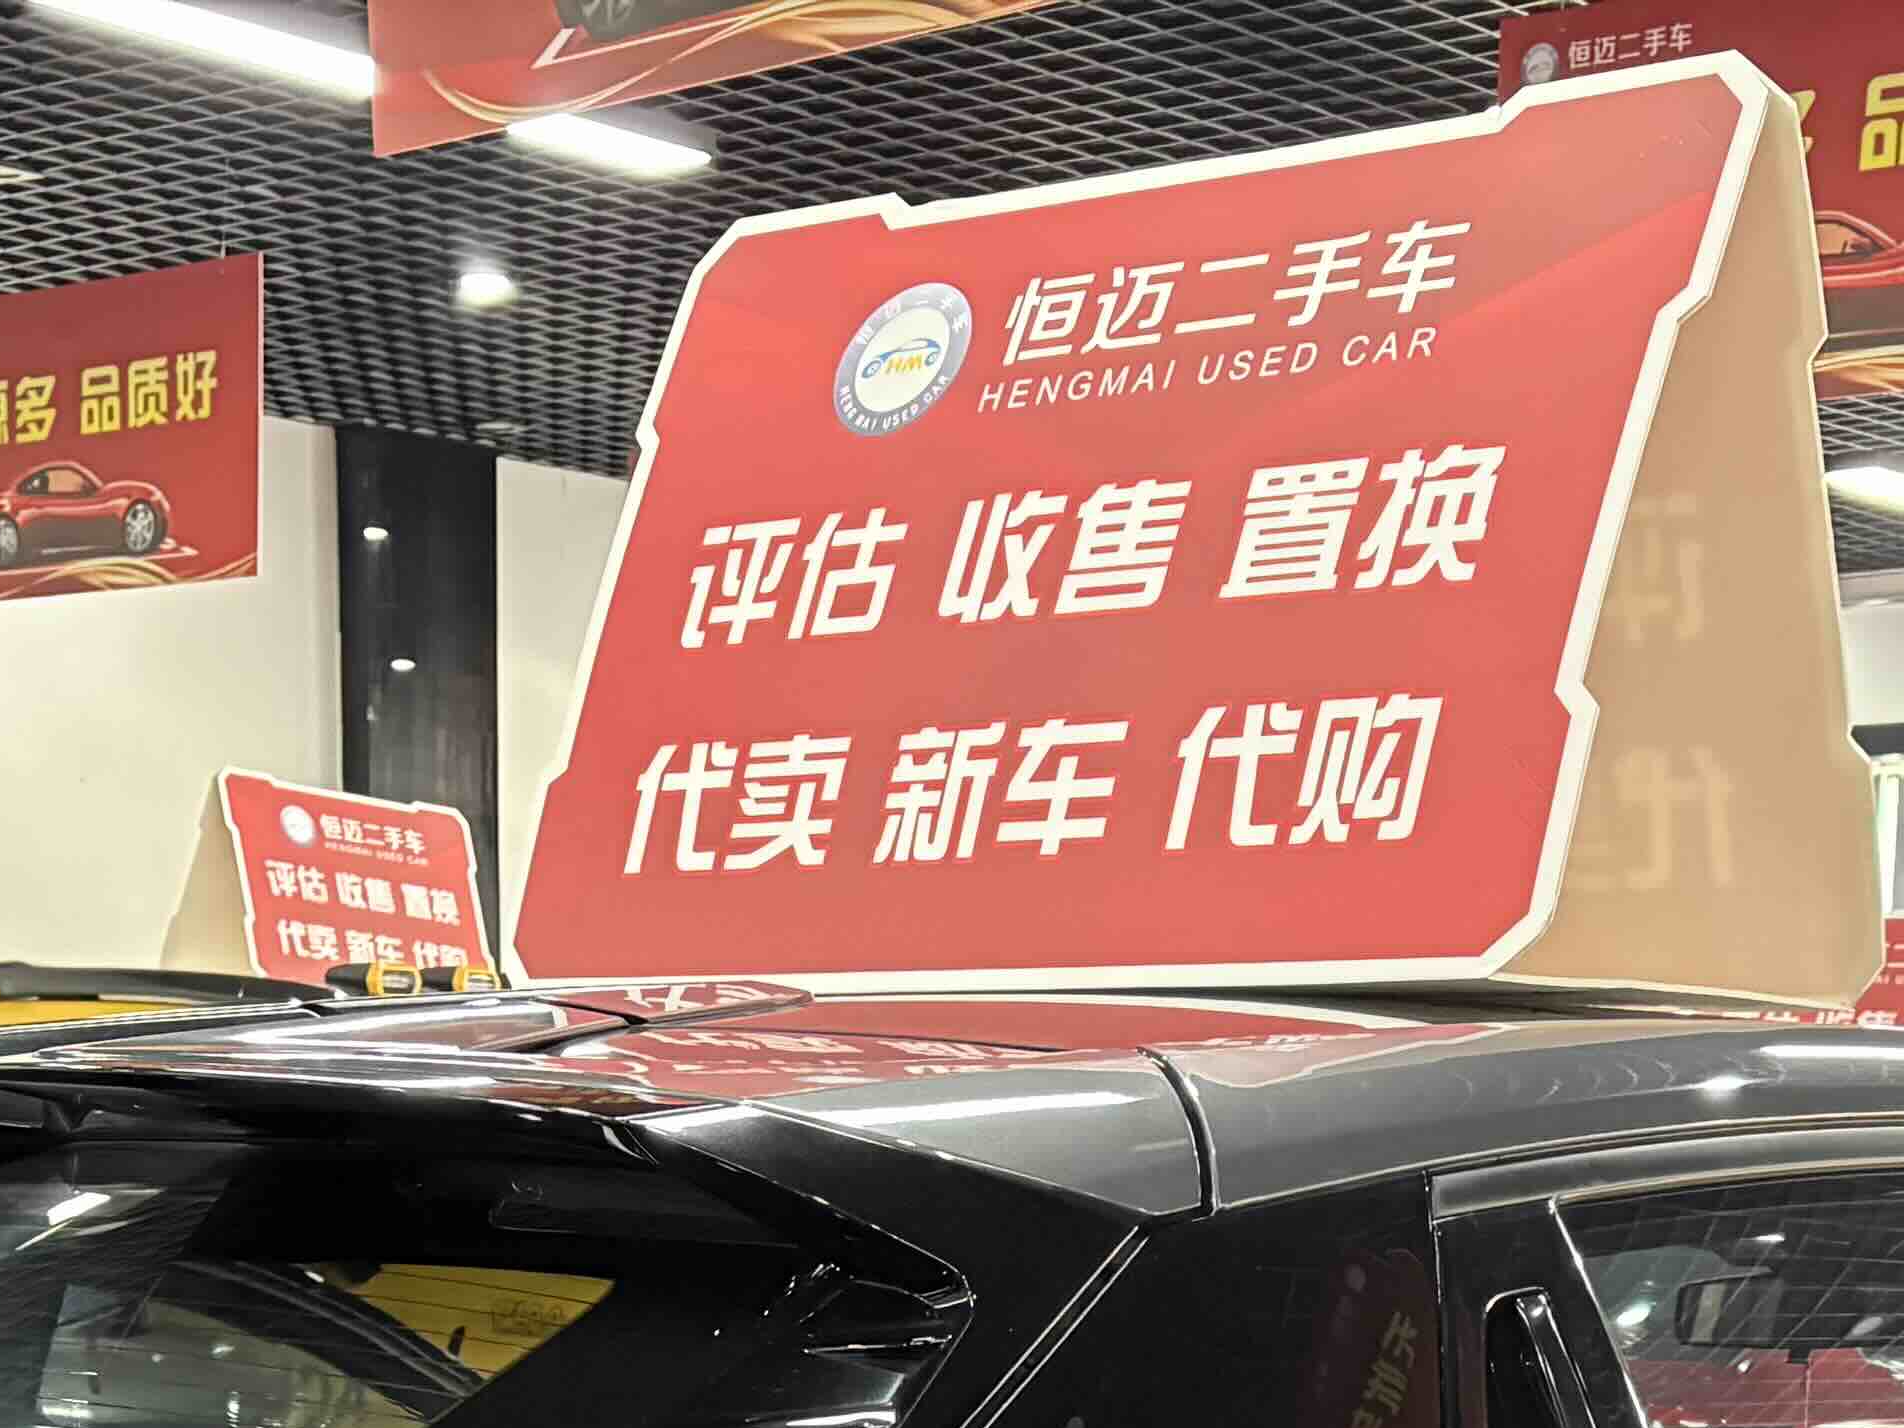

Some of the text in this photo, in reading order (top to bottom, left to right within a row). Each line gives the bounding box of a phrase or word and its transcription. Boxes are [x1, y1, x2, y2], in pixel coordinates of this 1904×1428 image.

[1568, 22, 1693, 69] 恒迈二手车
[1003, 219, 1472, 366] 恒迈二手车
[79, 349, 217, 435] 品质好
[977, 326, 1437, 412] HENGMAI USED CAR
[678, 444, 1508, 650] 评估 收售 置换
[623, 694, 1443, 875] 代卖 新车 代购
[264, 859, 329, 904] 评估
